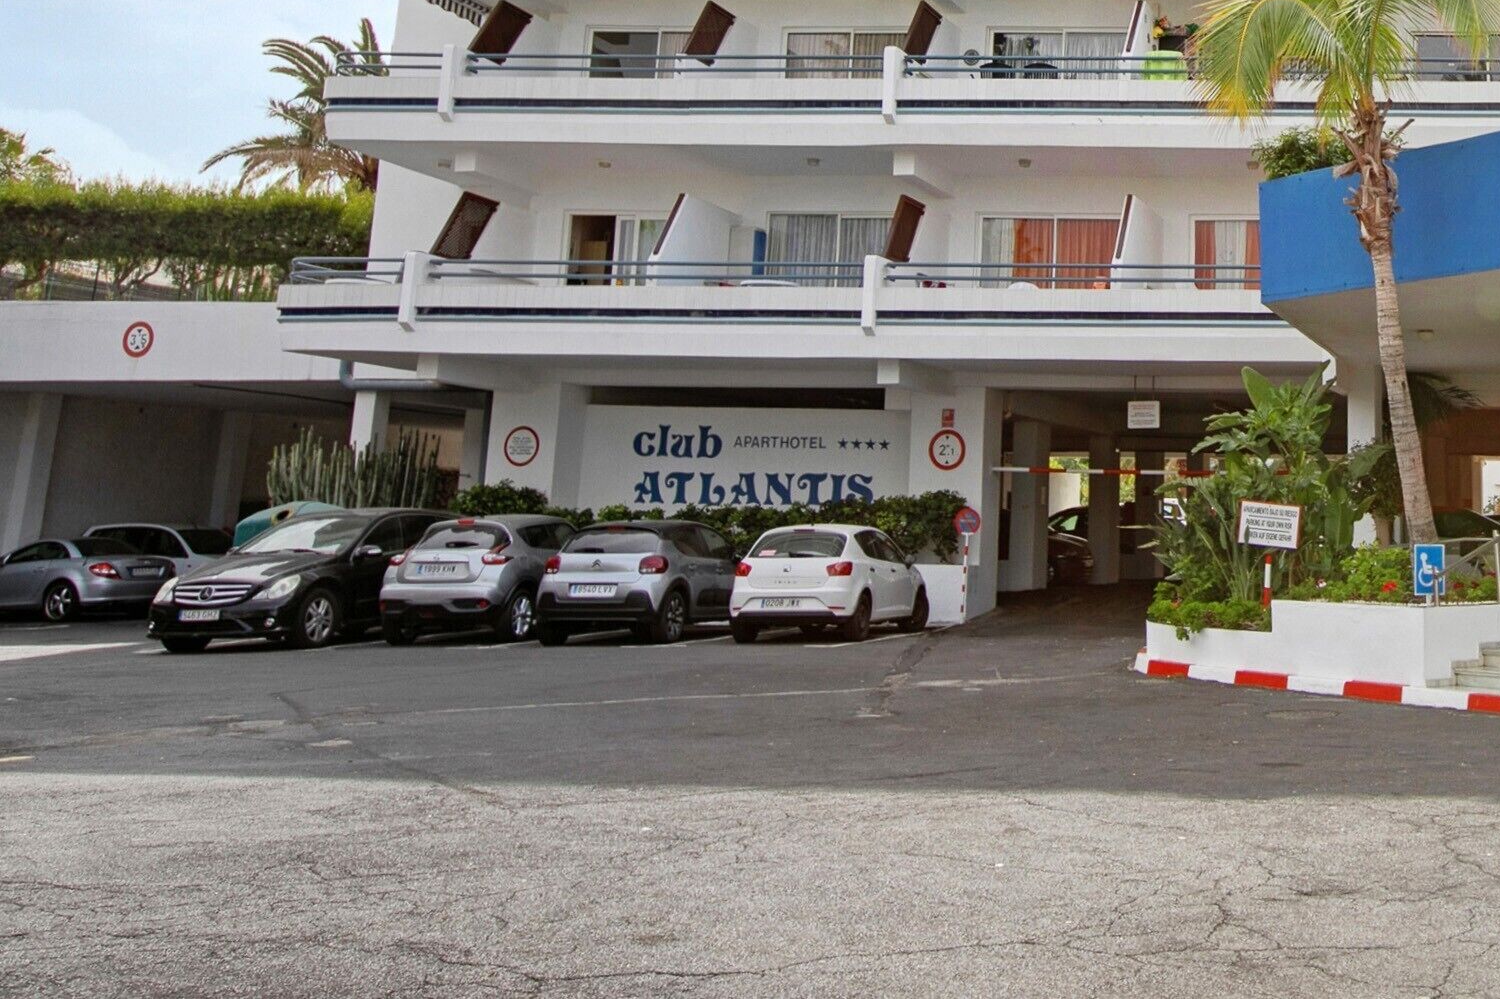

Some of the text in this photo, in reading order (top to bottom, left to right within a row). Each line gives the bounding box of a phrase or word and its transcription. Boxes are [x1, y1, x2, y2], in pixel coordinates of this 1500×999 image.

[633, 424, 827, 459] club APARTHOTEL
[634, 471, 874, 506] ATLANTIS
